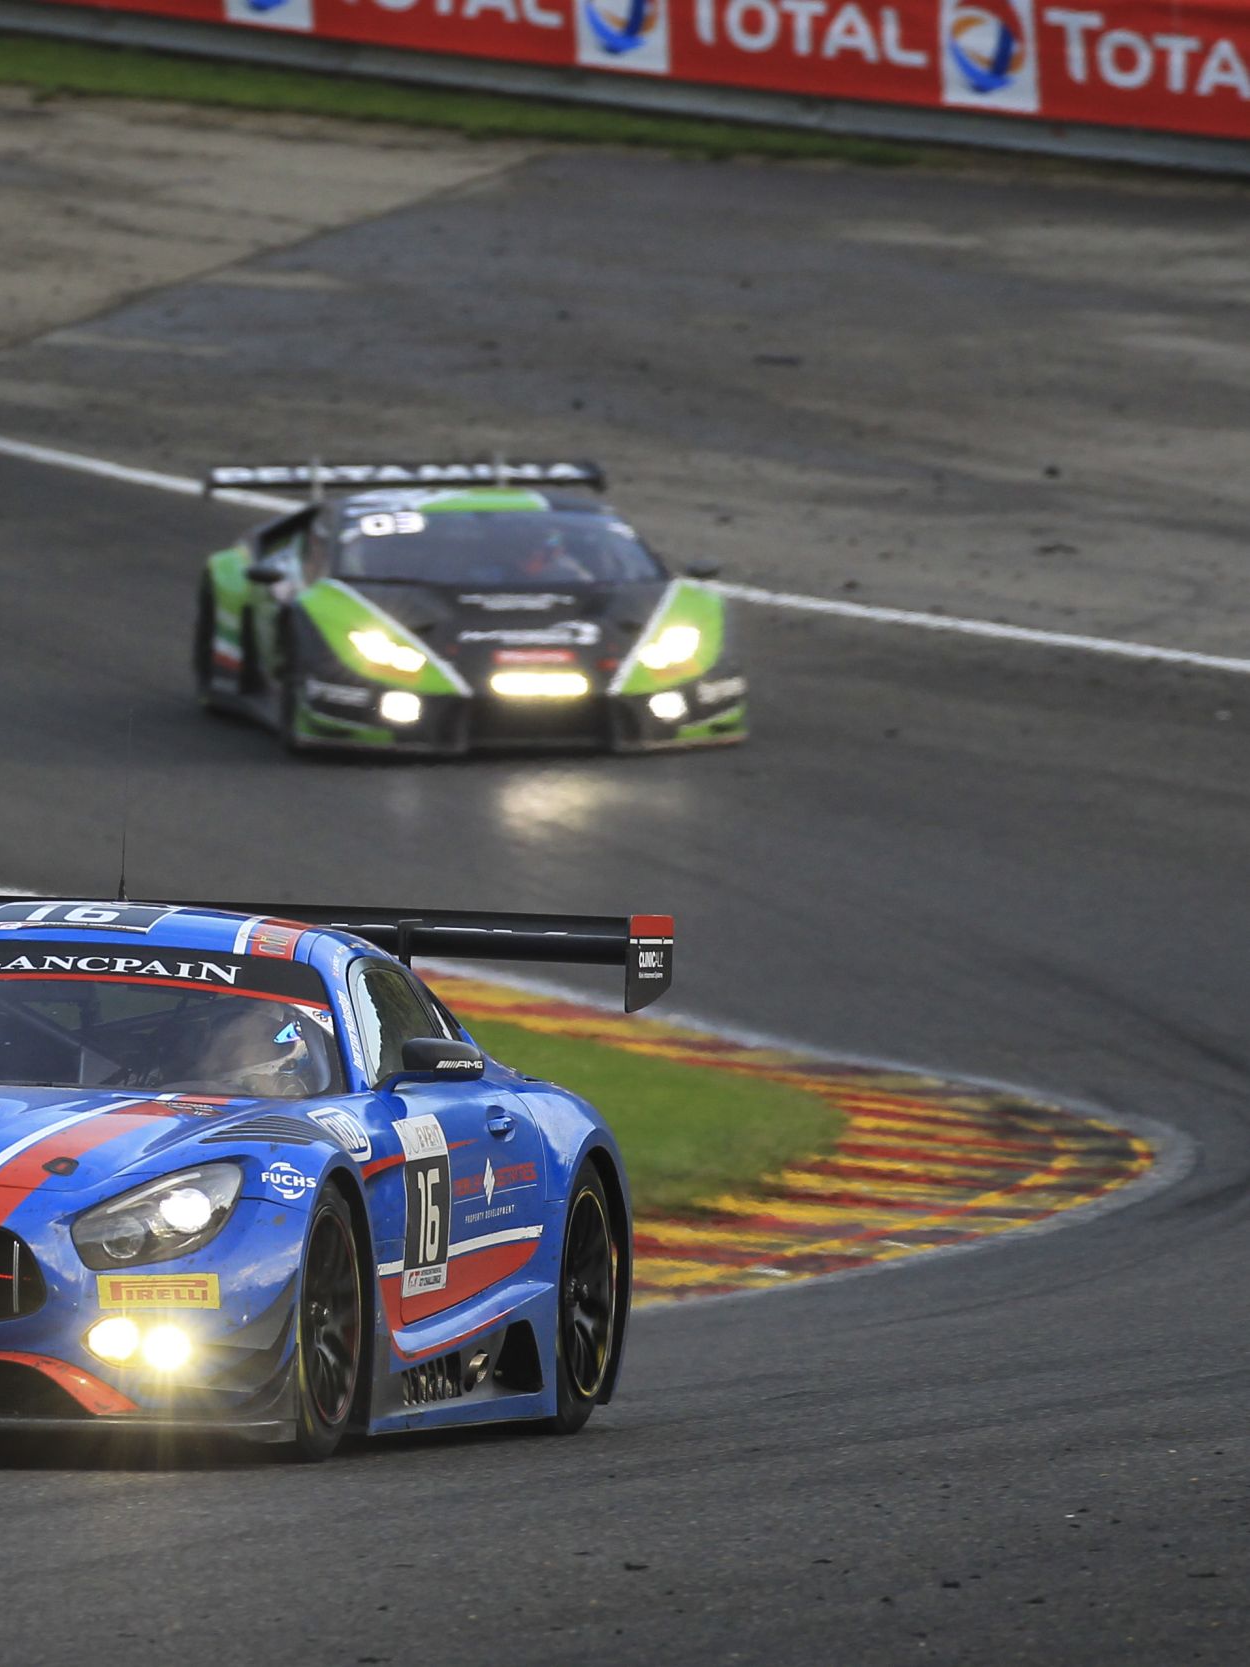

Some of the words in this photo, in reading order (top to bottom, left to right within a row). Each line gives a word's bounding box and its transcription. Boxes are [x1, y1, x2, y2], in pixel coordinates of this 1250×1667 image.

[25, 904, 130, 923] 16
[455, 1060, 484, 1070] AMG
[261, 1171, 317, 1188] FUCHS
[417, 1168, 441, 1264] 16
[109, 1279, 209, 1301] PIRELLI
